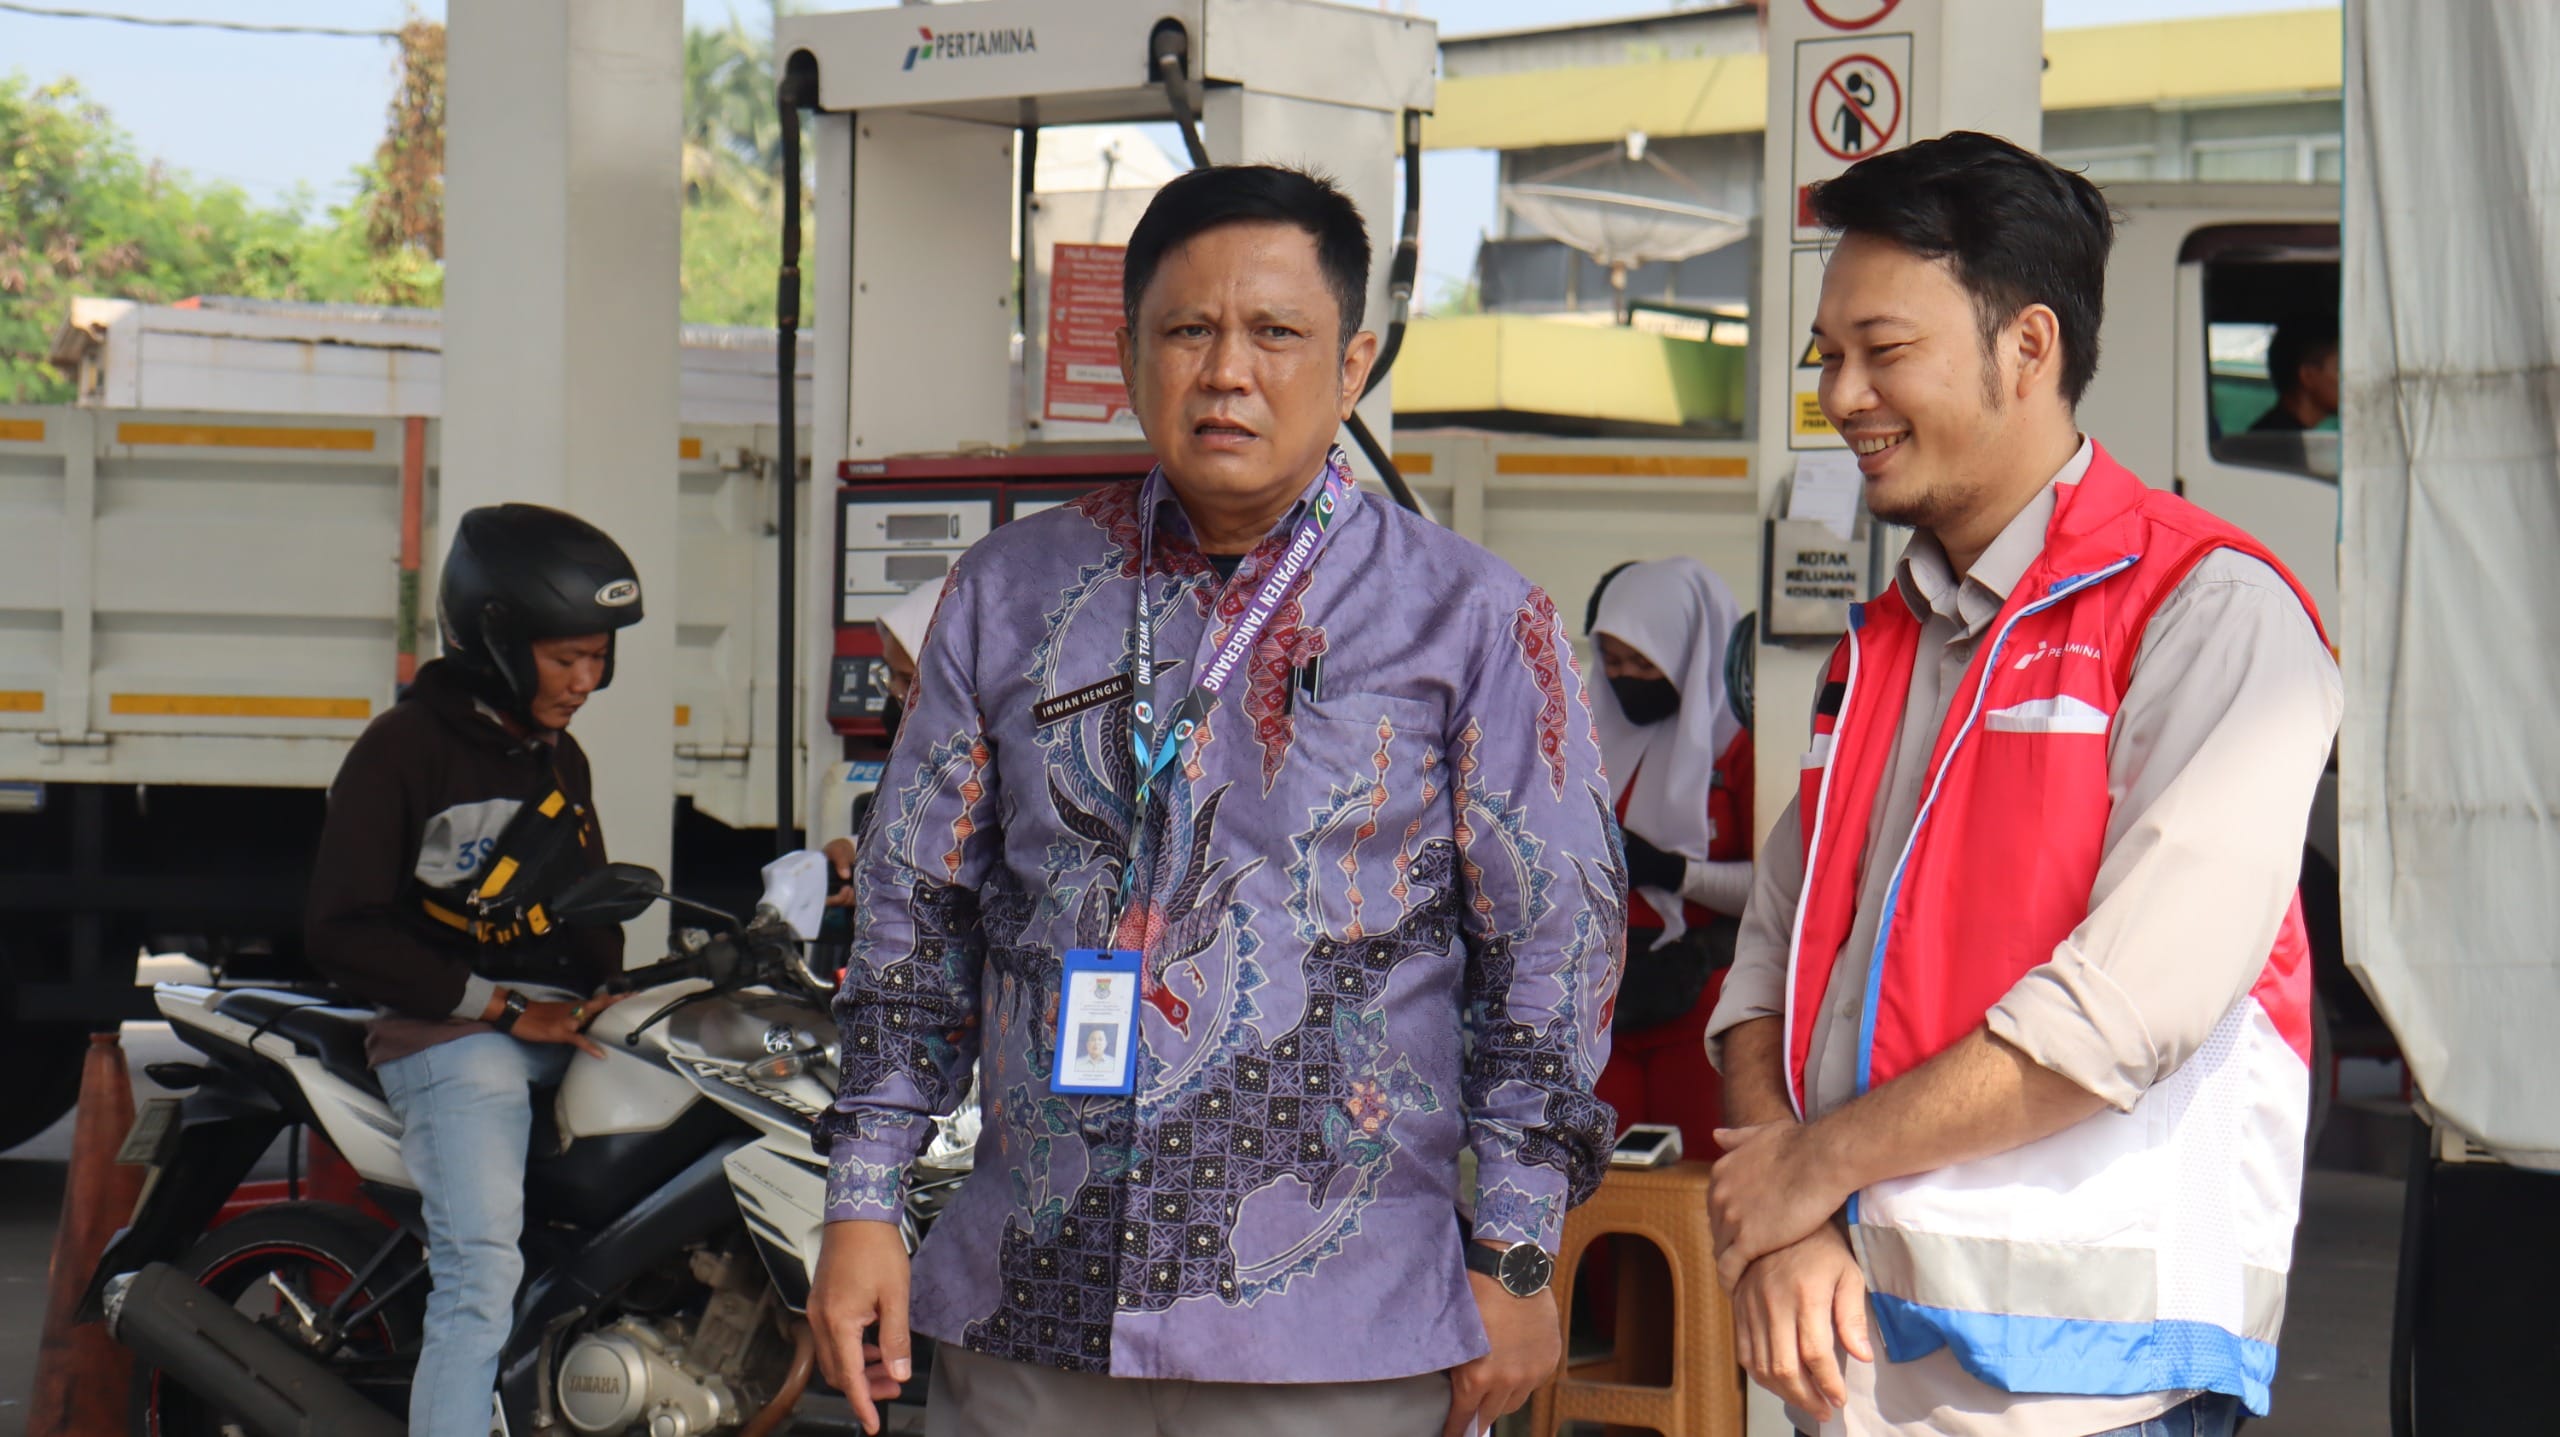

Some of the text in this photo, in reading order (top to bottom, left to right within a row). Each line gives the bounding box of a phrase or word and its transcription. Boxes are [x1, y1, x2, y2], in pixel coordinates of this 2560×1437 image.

[936, 27, 1036, 59] PERTAMINA
[1797, 551, 1849, 566] KOTAK
[1785, 569, 1857, 582] KELUHAN
[1139, 594, 1149, 616] ONE
[1203, 526, 1318, 692] KABUPATEN TANGERANG
[1138, 620, 1150, 658] TEAM.
[1138, 660, 1151, 686] ONE
[1042, 681, 1123, 718] IRWAN HENGKI
[569, 1376, 620, 1395] YAMAHA
